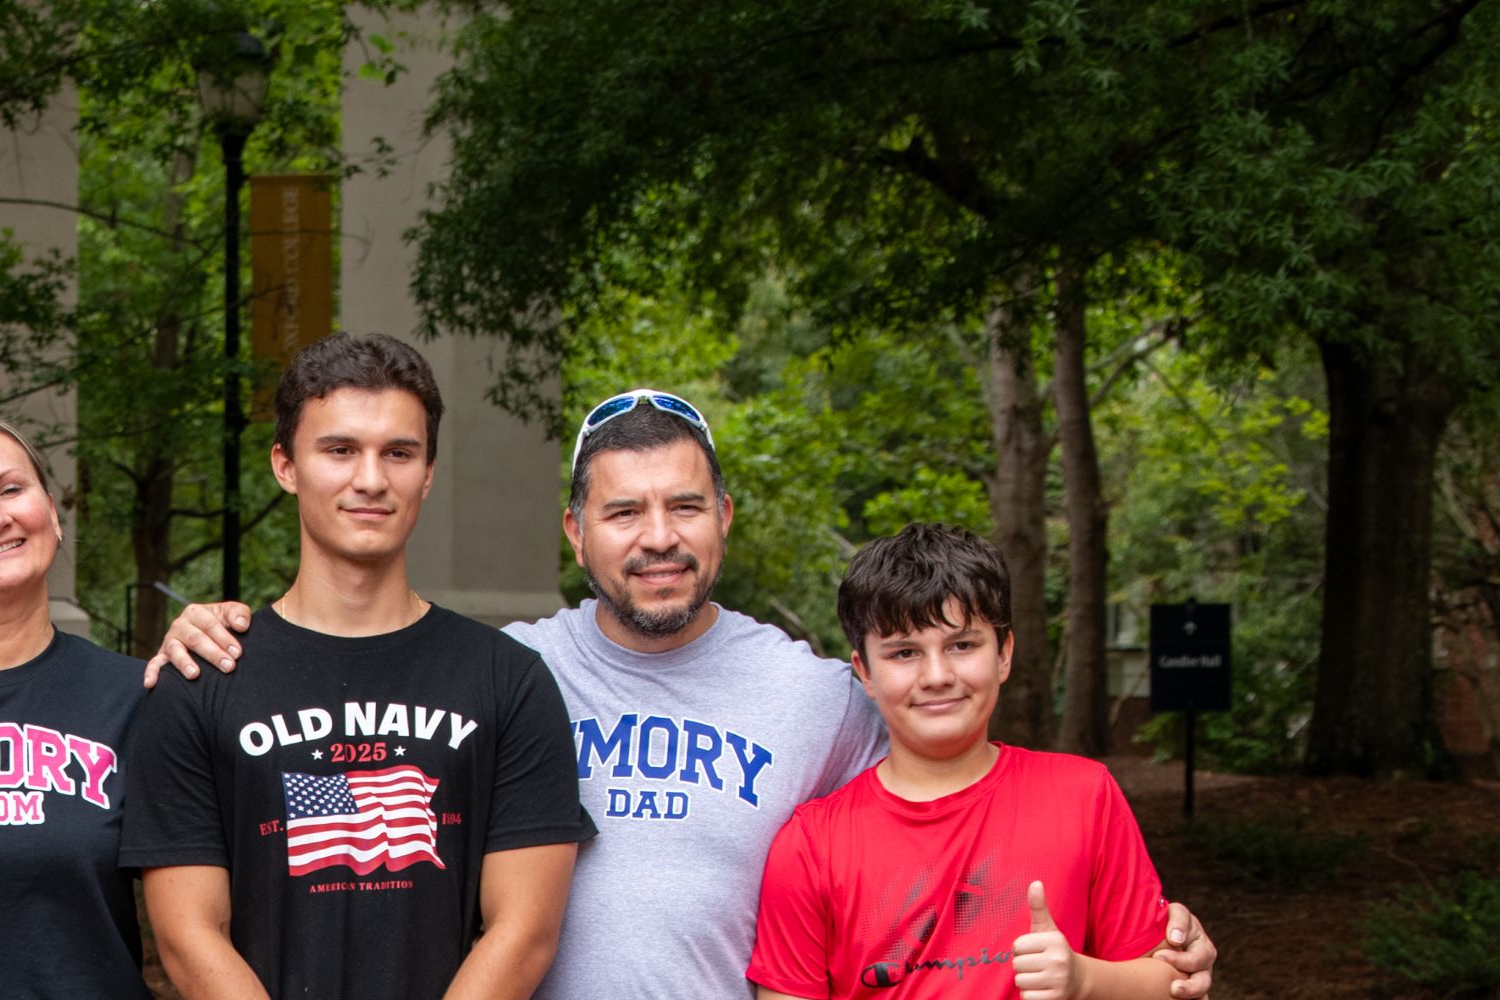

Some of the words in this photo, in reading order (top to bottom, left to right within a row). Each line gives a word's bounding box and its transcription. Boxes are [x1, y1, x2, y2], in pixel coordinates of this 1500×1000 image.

[239, 708, 333, 756] OLD
[344, 702, 478, 750] NAVY
[330, 742, 387, 763] 2025
[571, 712, 773, 809] MORY
[605, 788, 690, 820] DAD
[260, 819, 284, 836] EST.
[309, 881, 355, 893] AMERICN
